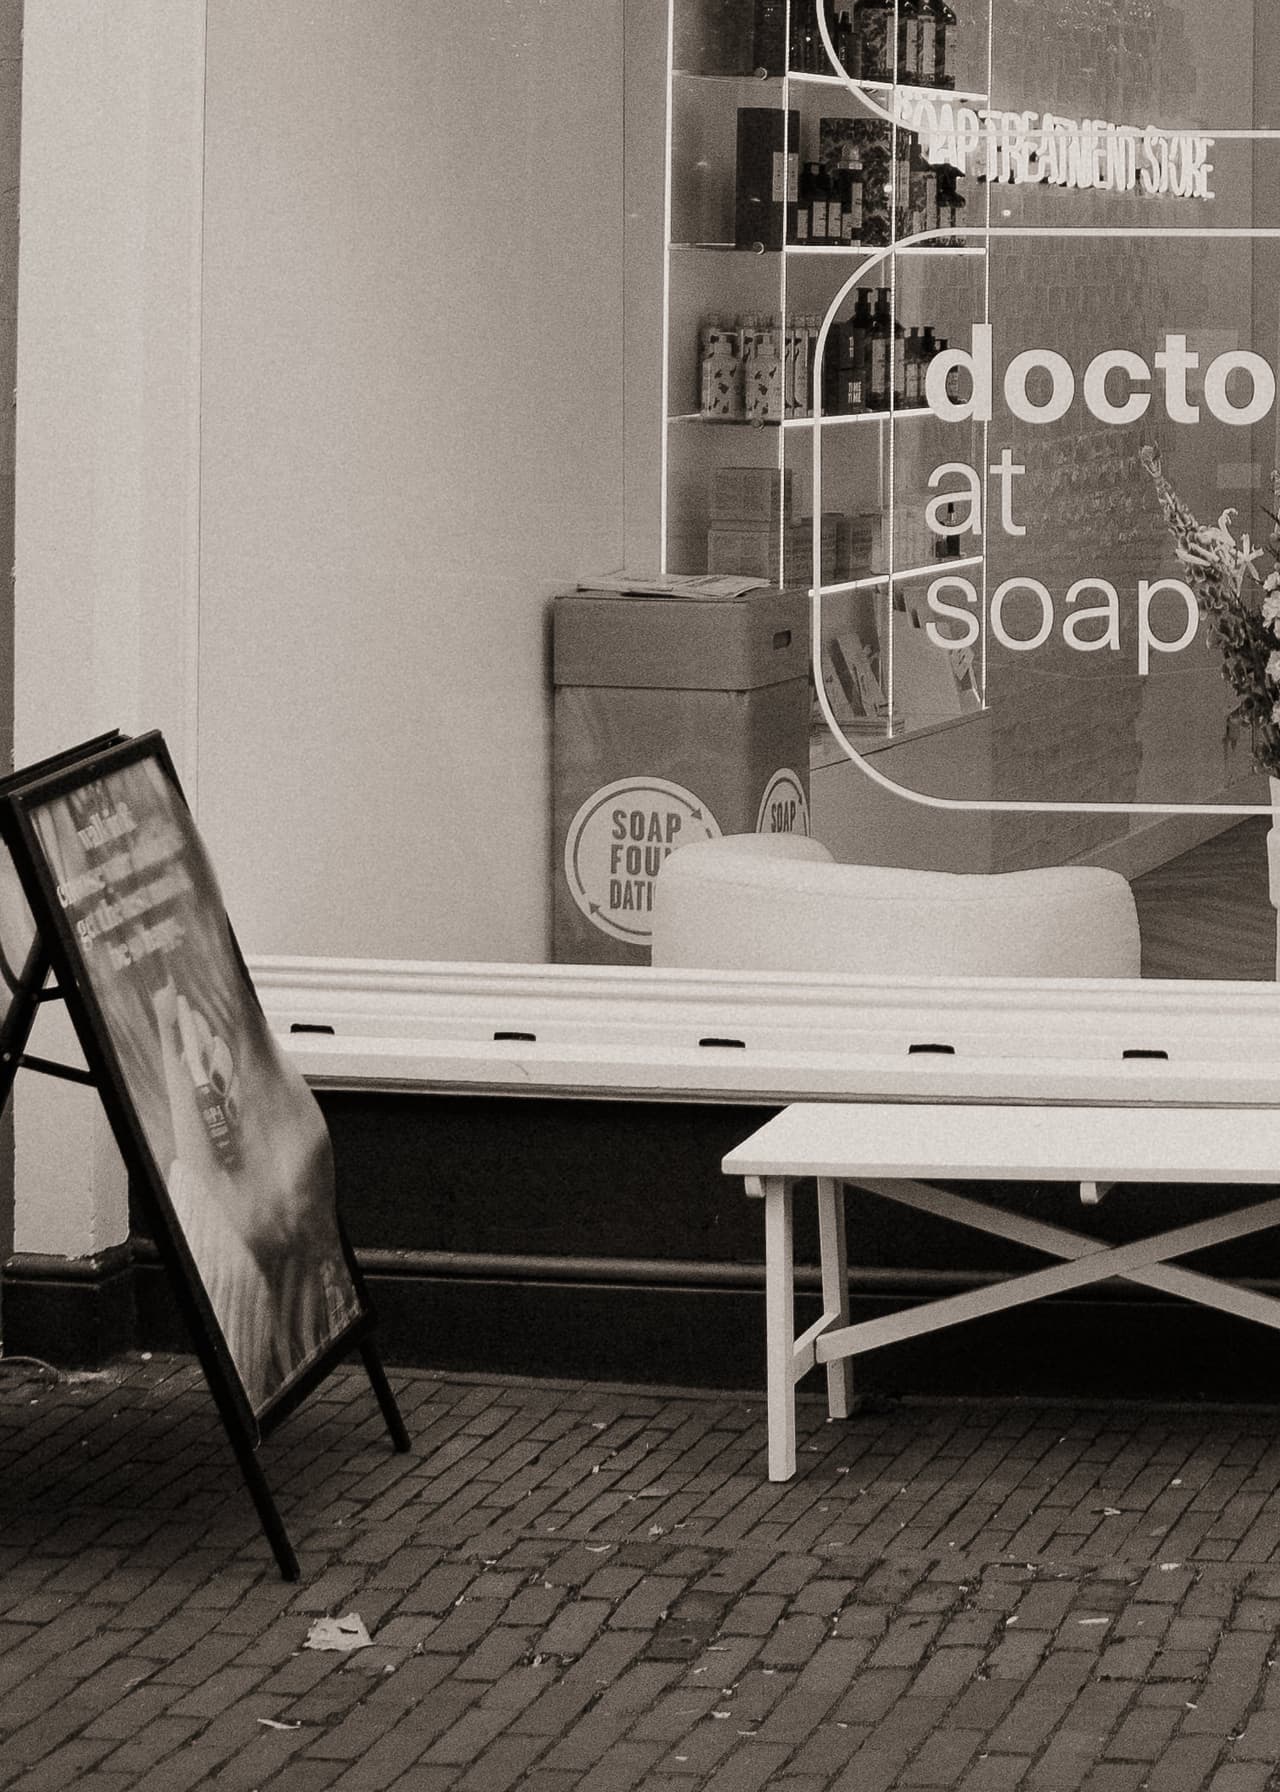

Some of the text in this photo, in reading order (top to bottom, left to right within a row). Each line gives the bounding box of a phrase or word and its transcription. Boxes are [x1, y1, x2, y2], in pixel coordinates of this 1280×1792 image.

[926, 449, 1026, 538] at
[925, 577, 1198, 676] soap
[611, 809, 682, 844] SOAP
[771, 799, 797, 834] SOAP
